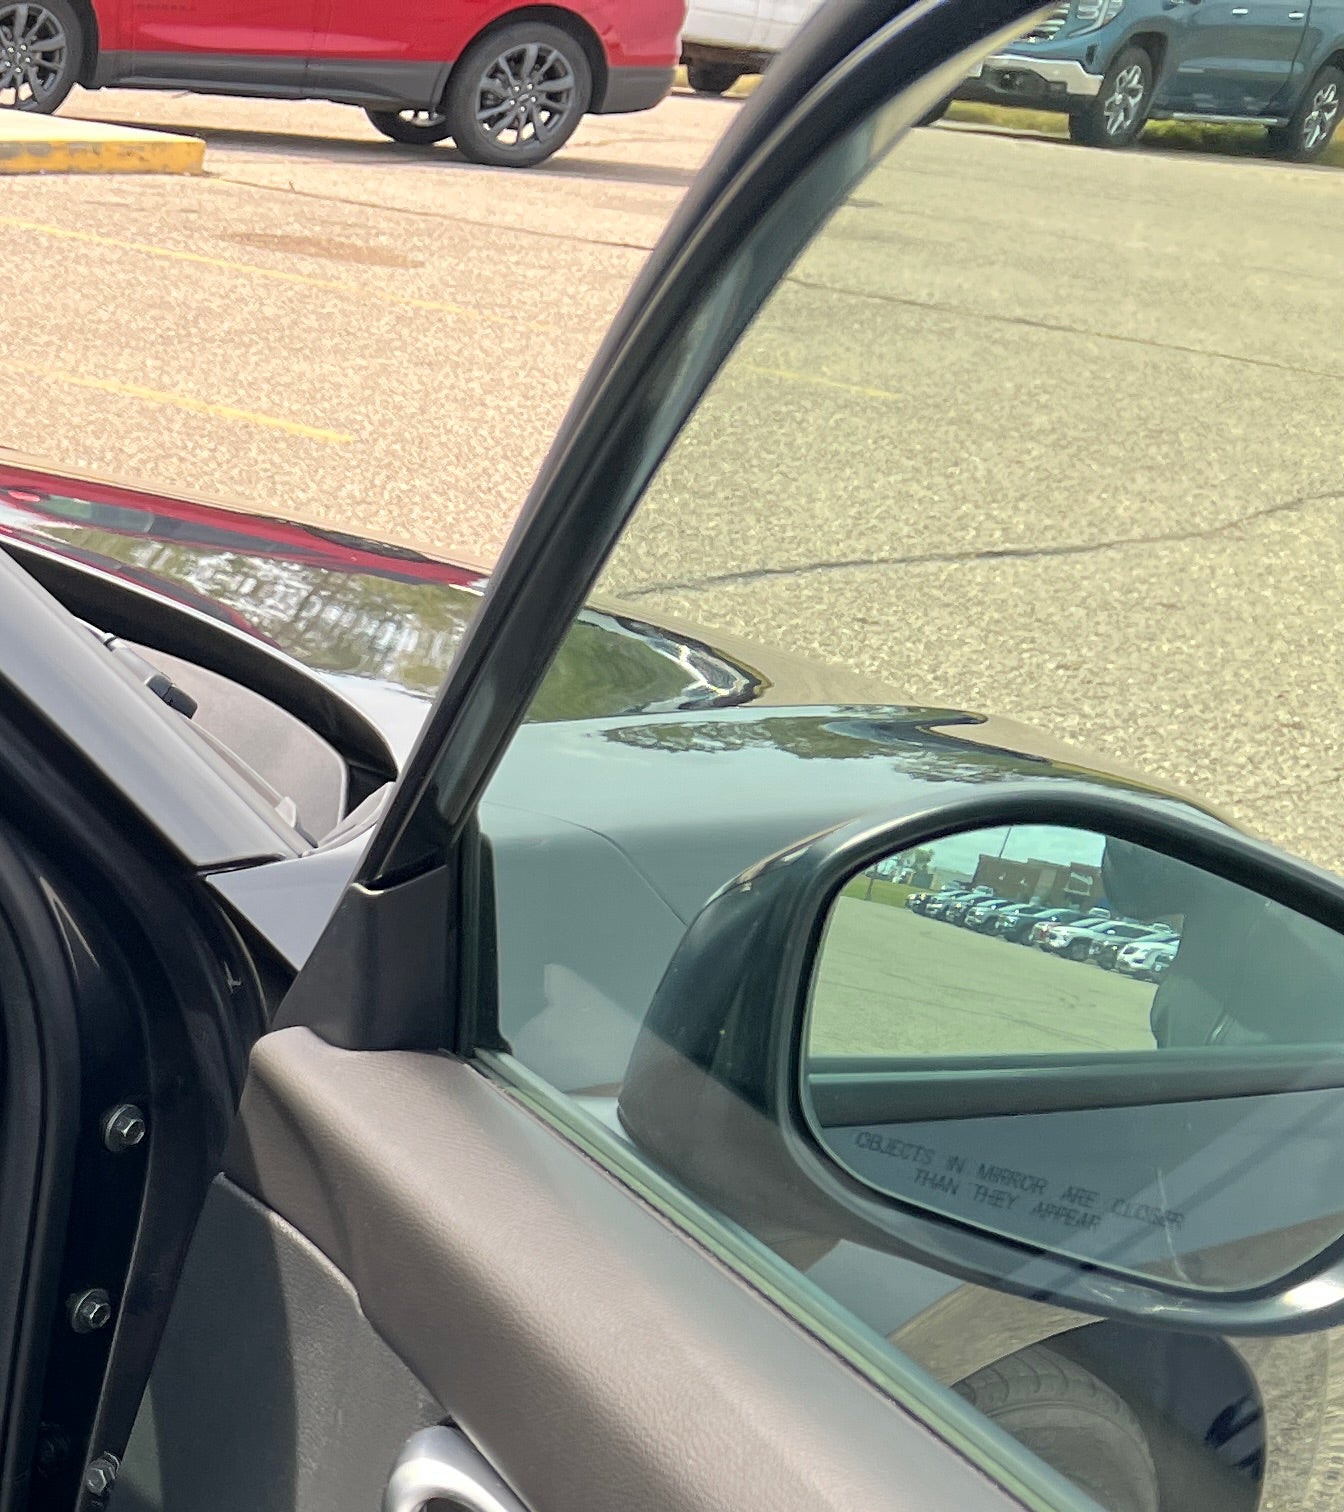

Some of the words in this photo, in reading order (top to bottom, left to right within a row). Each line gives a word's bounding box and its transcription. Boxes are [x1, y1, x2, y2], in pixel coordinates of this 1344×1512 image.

[855, 1131, 936, 1165] OBJECTS
[946, 1155, 966, 1174] IN
[977, 1163, 1049, 1195] MIRROR
[1060, 1186, 1101, 1209] ARE
[914, 1168, 960, 1195] THAN
[969, 1182, 1020, 1209] THEY
[1031, 1200, 1103, 1233] APPEAR
